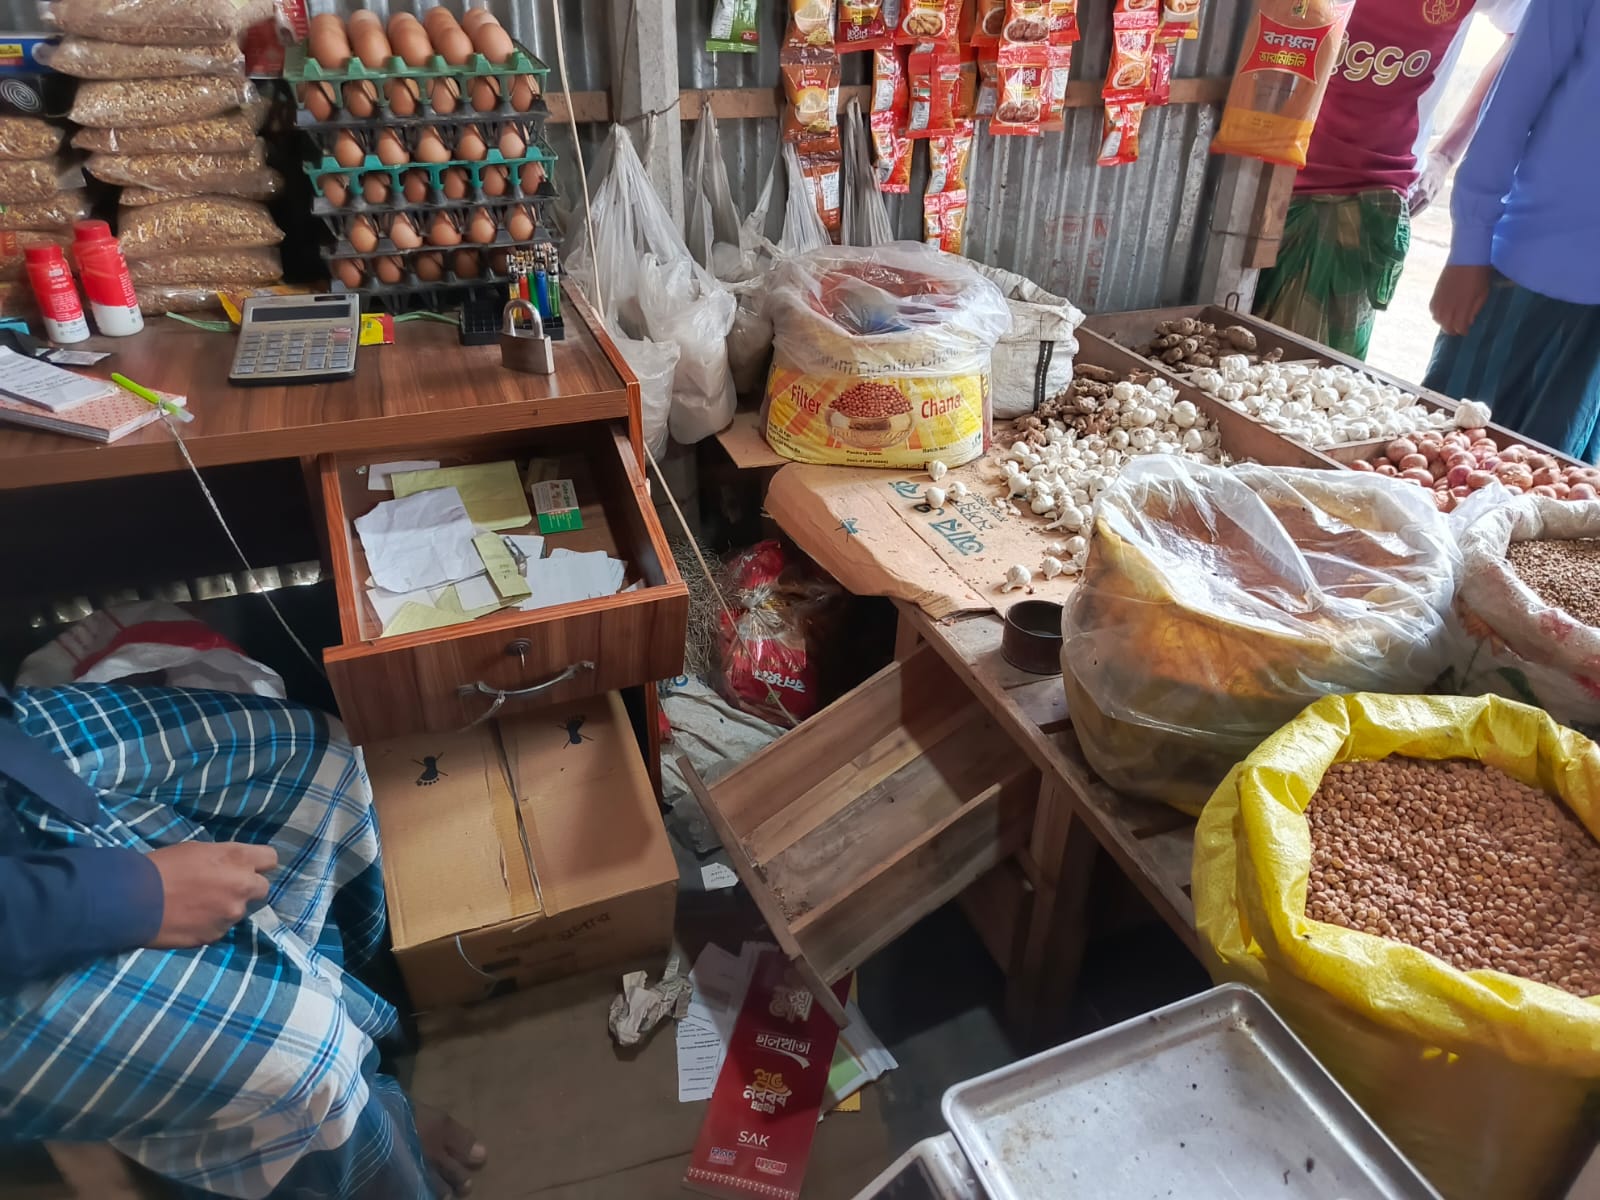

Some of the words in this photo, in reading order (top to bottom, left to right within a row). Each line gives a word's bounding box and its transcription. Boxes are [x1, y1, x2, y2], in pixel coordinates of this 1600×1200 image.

[1263, 31, 1318, 52] বনফুল
[1330, 30, 1432, 86] iggo
[791, 384, 822, 415] Filter
[921, 393, 962, 419] Chana
[755, 1033, 811, 1055] হালখাতা
[752, 1067, 789, 1093] শুভ
[738, 1130, 771, 1147] SAK
